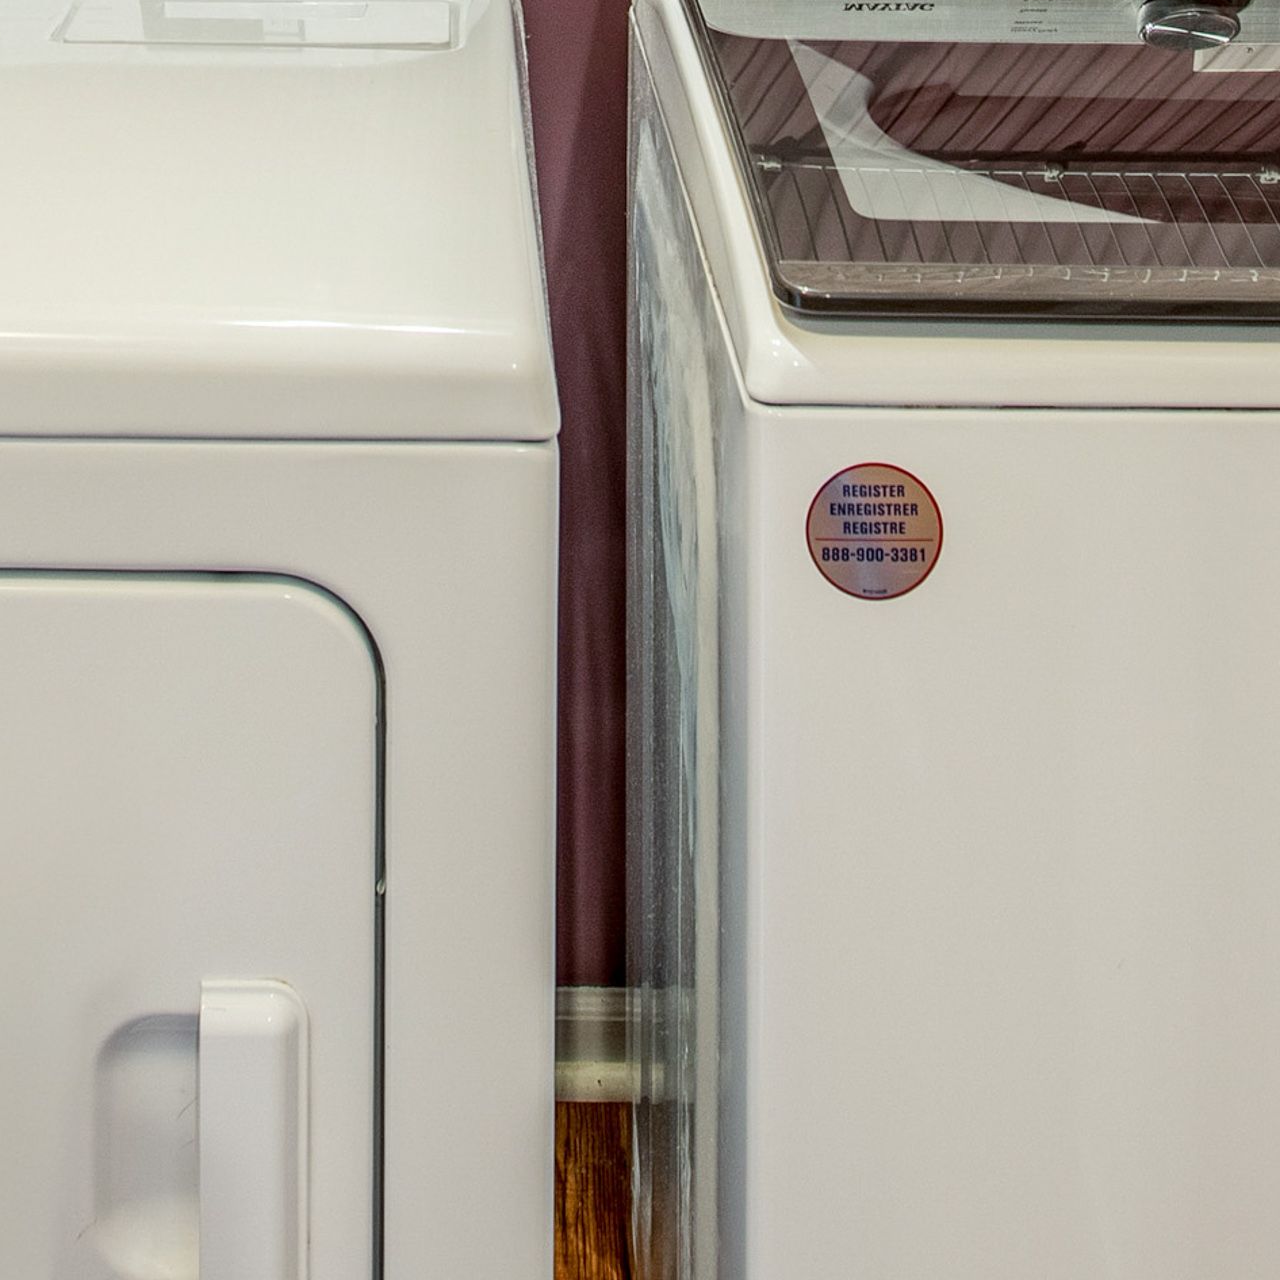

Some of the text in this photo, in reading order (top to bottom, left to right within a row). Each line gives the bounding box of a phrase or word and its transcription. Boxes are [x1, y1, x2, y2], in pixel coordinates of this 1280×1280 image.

[842, 484, 905, 498] REGISTER
[829, 502, 919, 517] ENREGISTRER
[843, 521, 907, 535] REGISTRE
[821, 547, 926, 563] 888-900-3381
